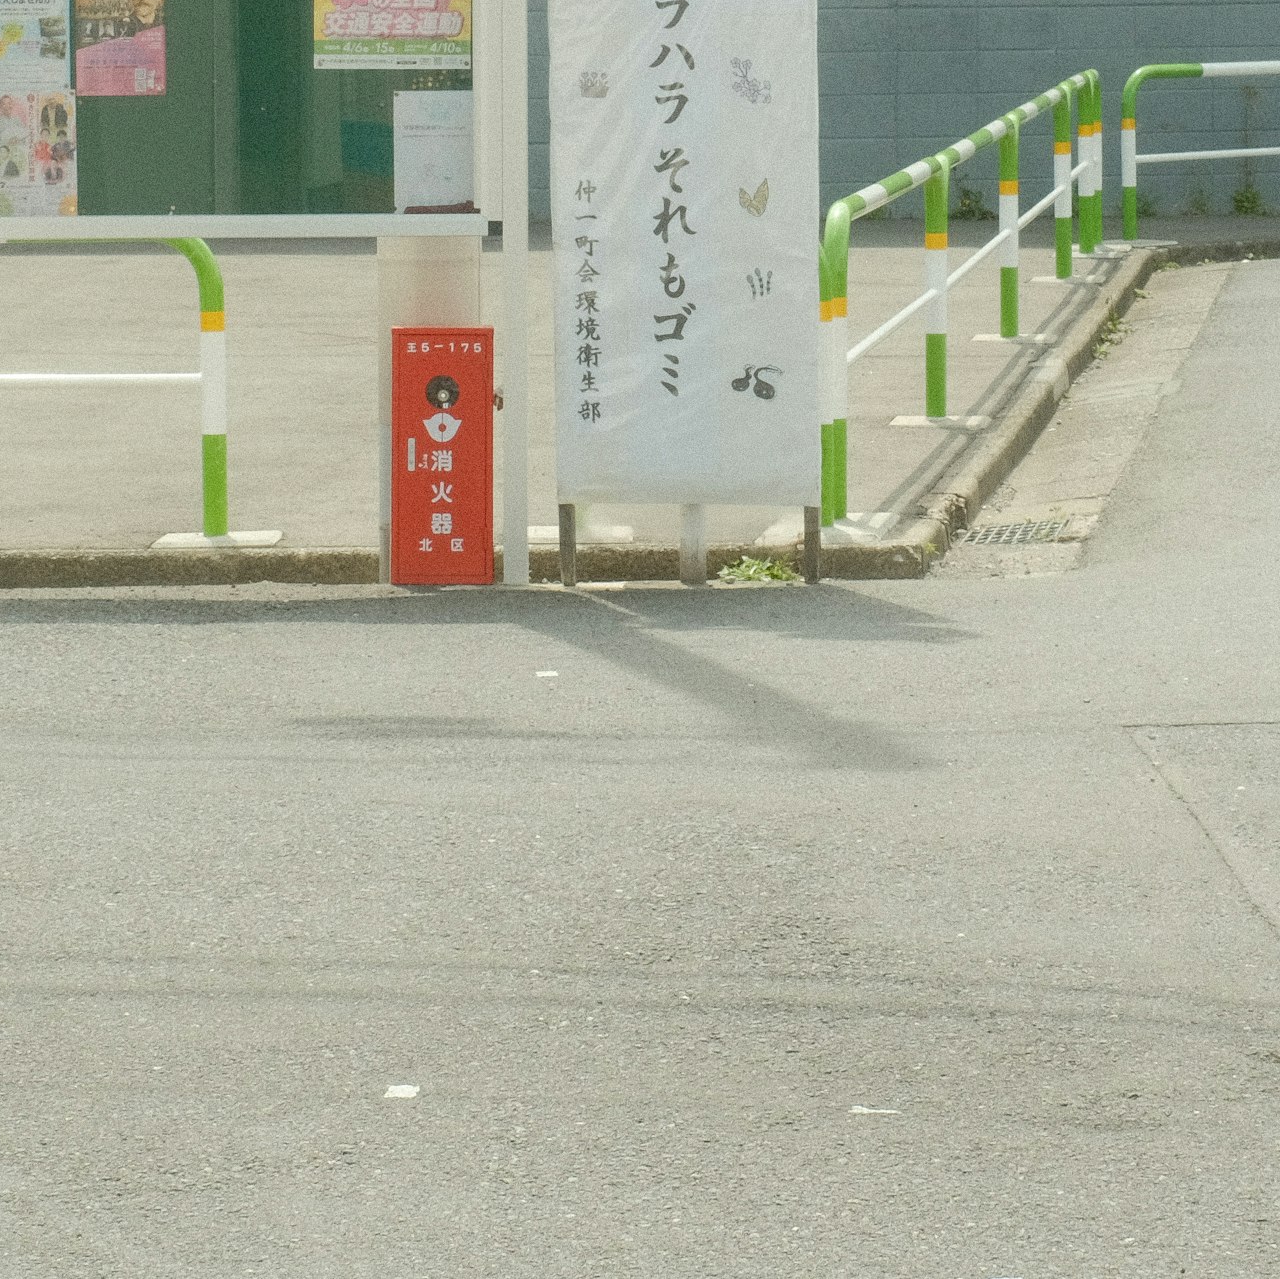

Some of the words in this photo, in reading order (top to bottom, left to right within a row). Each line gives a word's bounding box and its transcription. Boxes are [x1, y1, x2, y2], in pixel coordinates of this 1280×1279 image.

[574, 179, 602, 424] 仲一町会環境衛生部
[430, 449, 453, 535] 消火器
[418, 538, 464, 553] 北区
